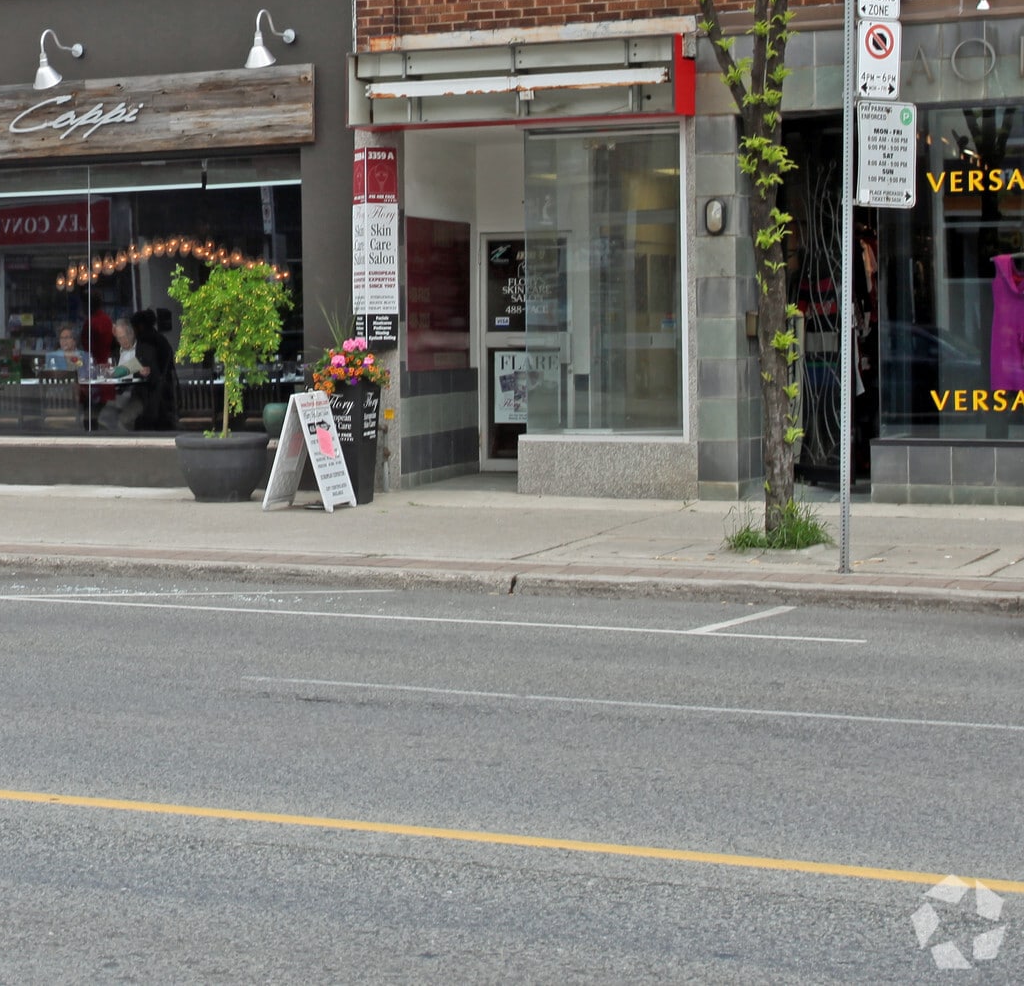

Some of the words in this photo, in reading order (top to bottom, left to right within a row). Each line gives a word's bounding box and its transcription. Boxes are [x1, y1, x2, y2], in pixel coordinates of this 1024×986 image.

[868, 4, 889, 16] ZONE
[367, 151, 387, 160] 3359
[387, 151, 395, 160] A
[370, 223, 392, 236] Skin
[369, 238, 392, 251] Care
[368, 251, 395, 265] Salon
[502, 286, 525, 294] SKIN
